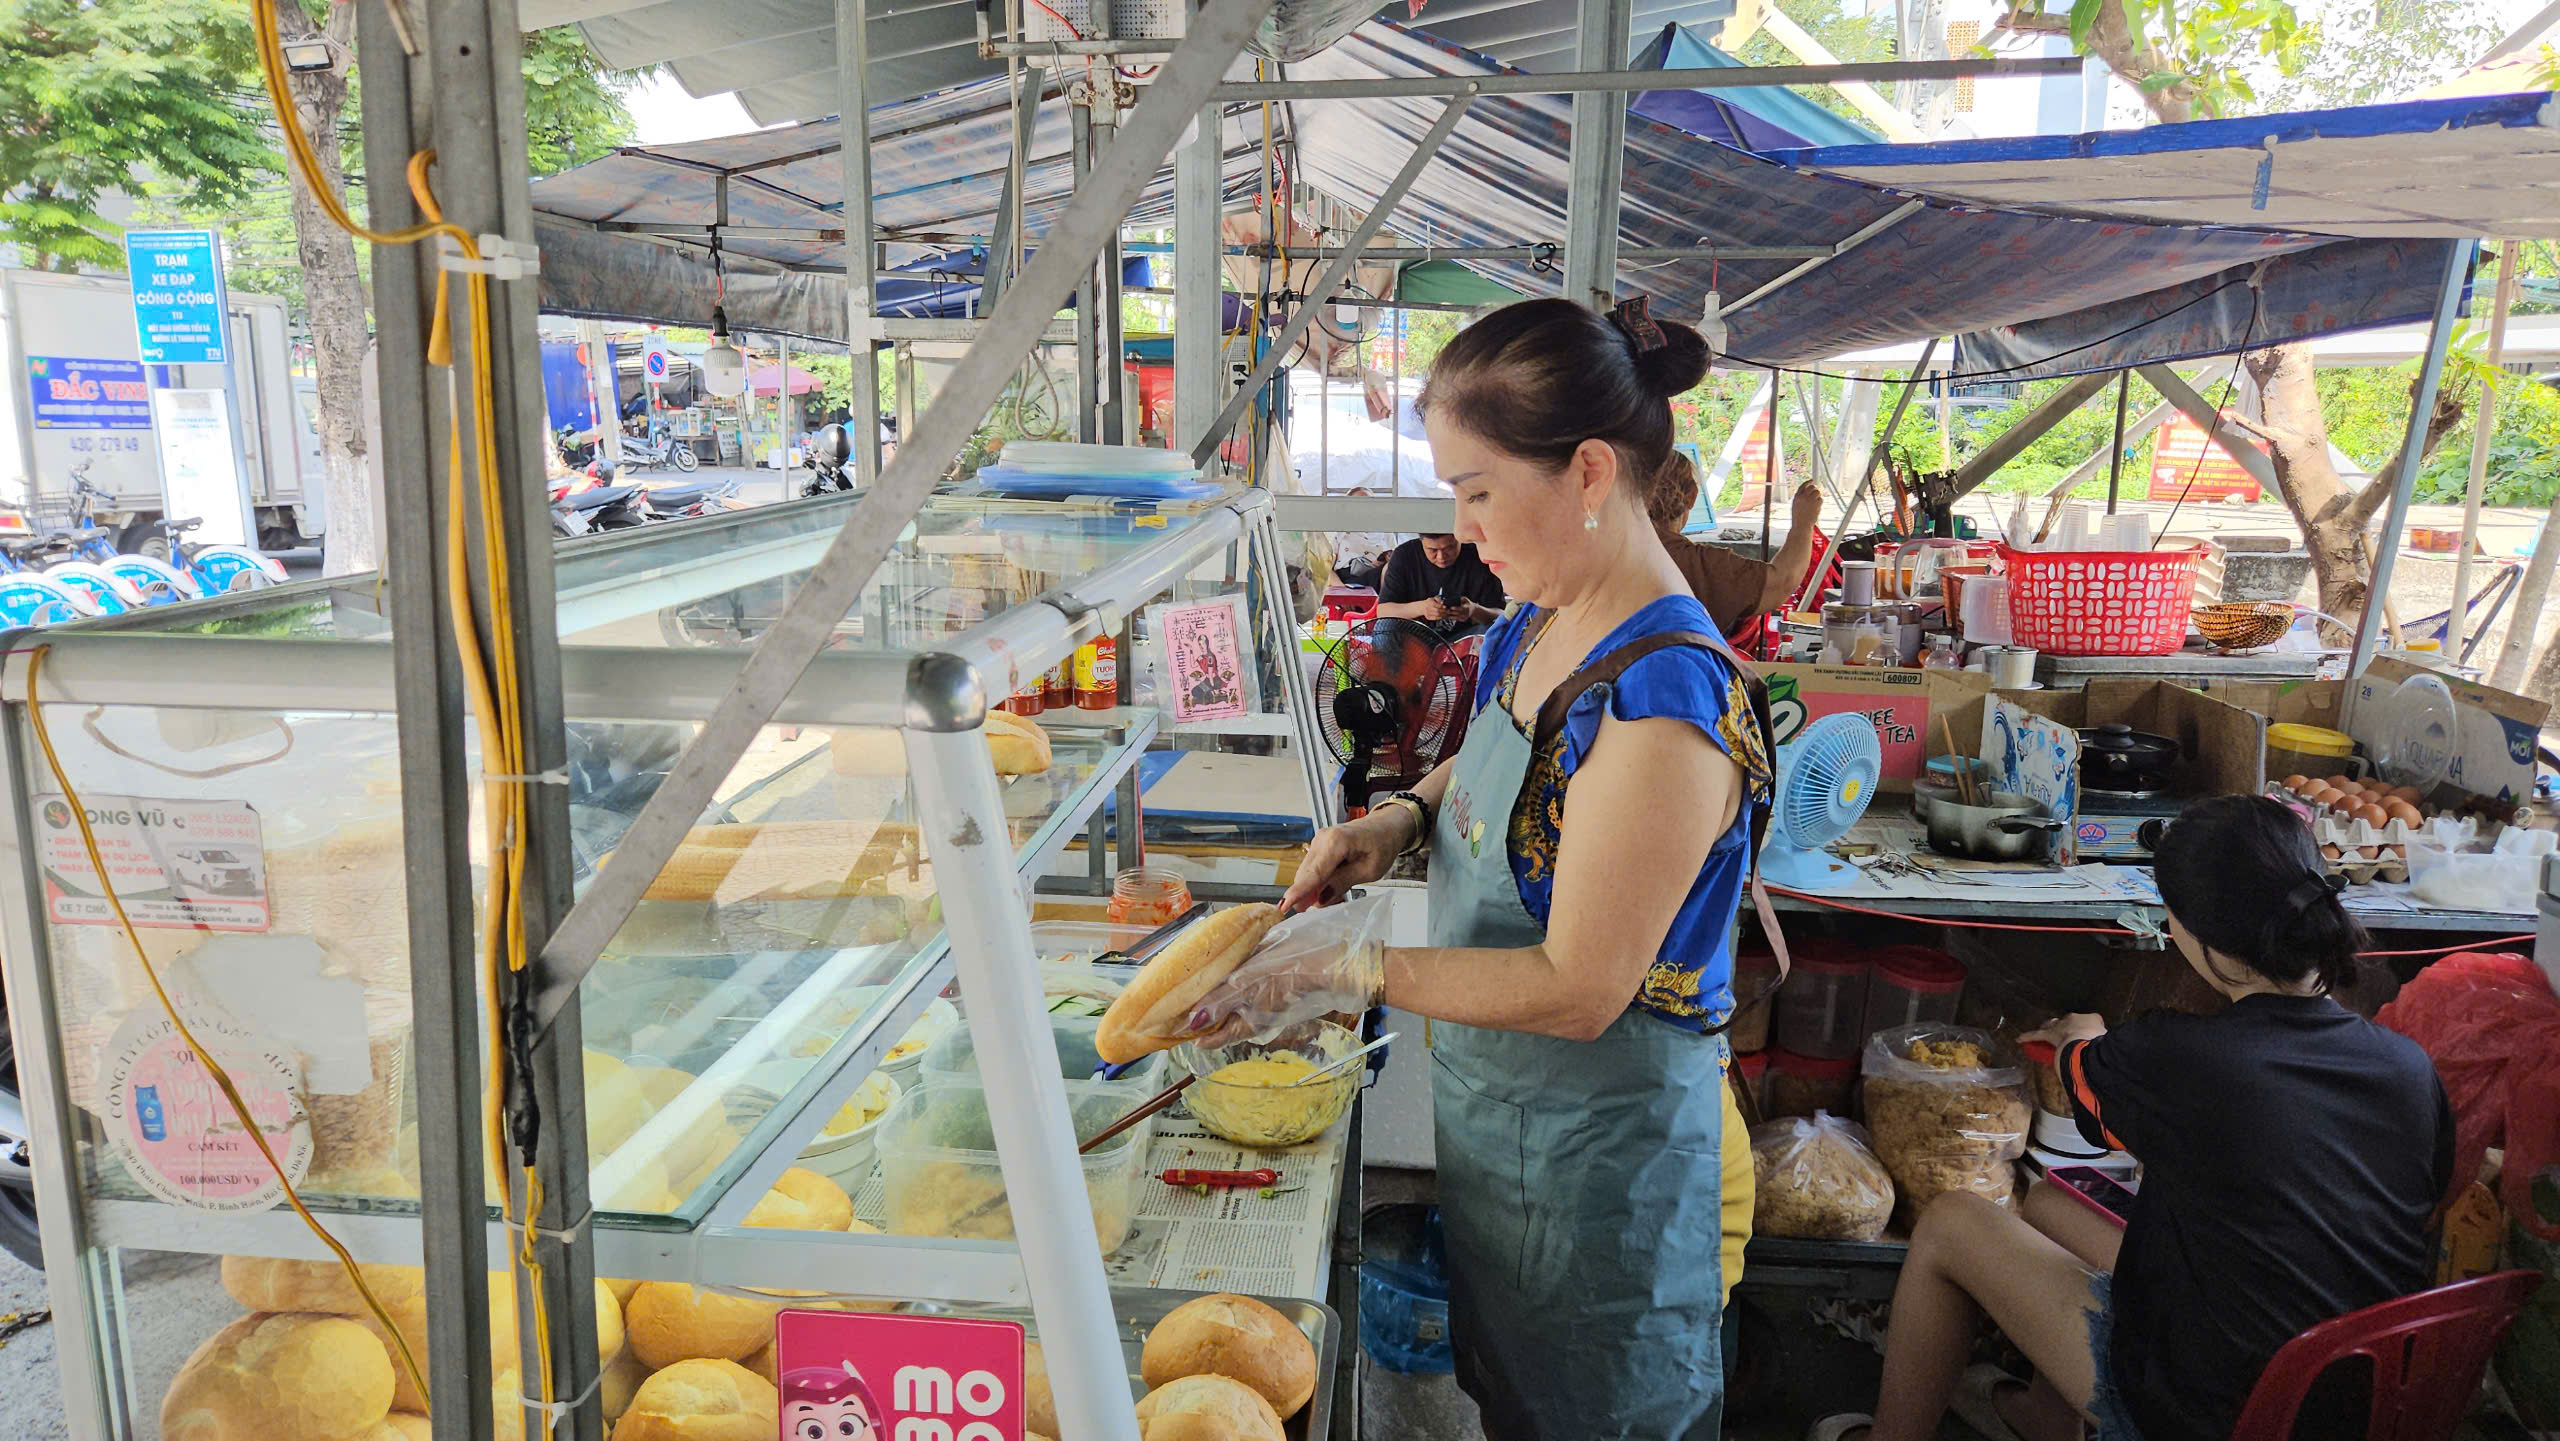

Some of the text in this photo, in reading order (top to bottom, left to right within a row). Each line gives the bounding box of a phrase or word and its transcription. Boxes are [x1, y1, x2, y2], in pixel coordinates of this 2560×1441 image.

[153, 253, 188, 269] TRẠM
[152, 273, 168, 286] XE
[136, 290, 215, 308] CÔNG CỘNG
[49, 371, 99, 400] ĐẮC
[1887, 674, 1918, 684] 600809
[2362, 685, 2372, 697] 28
[1884, 725, 1916, 745] TEA
[85, 808, 166, 828] ONG VŨ
[59, 904, 72, 914] XE
[76, 904, 84, 914] 7
[894, 1365, 1005, 1417] mo
